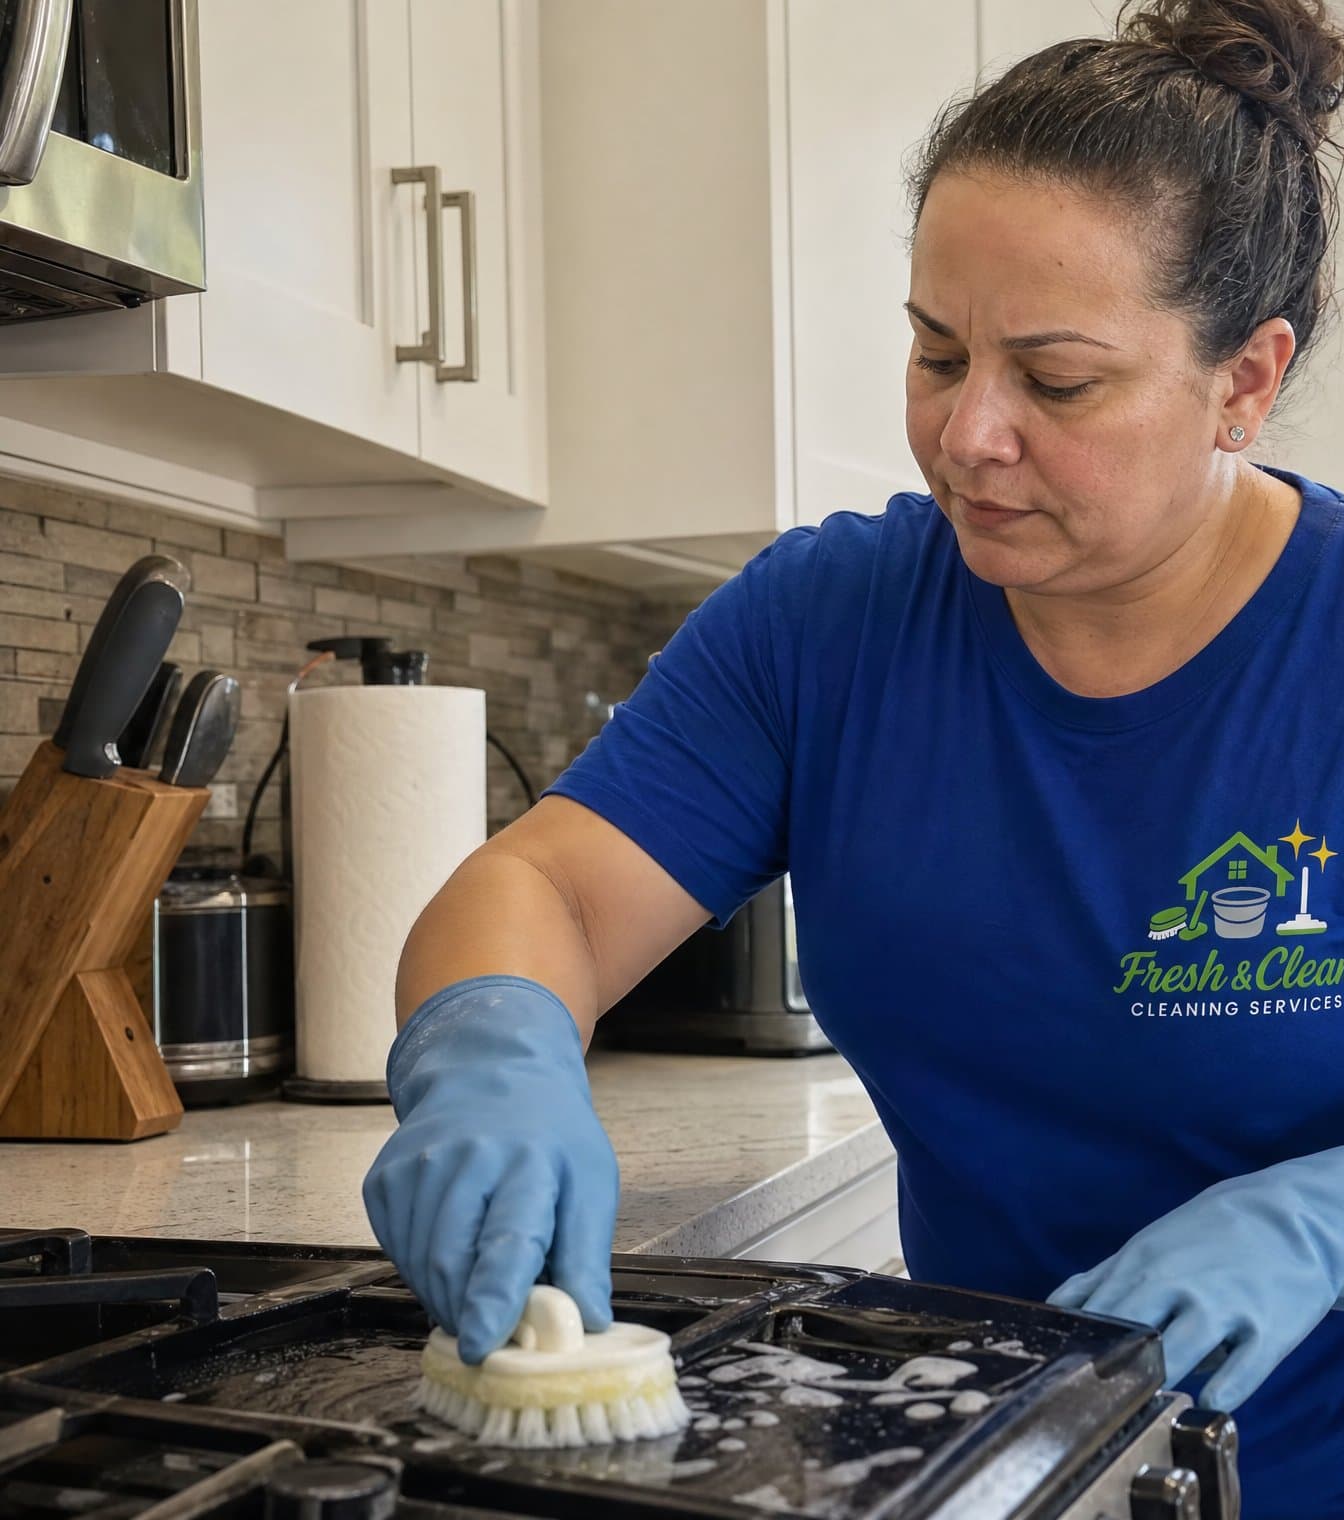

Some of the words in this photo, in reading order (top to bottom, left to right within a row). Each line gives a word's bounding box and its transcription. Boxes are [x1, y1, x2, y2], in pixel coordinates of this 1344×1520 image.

[1112, 949, 1229, 994] Fresh
[1231, 960, 1252, 991] &
[1130, 1001, 1239, 1017] CLEANING
[1249, 994, 1343, 1016] SERVICES
